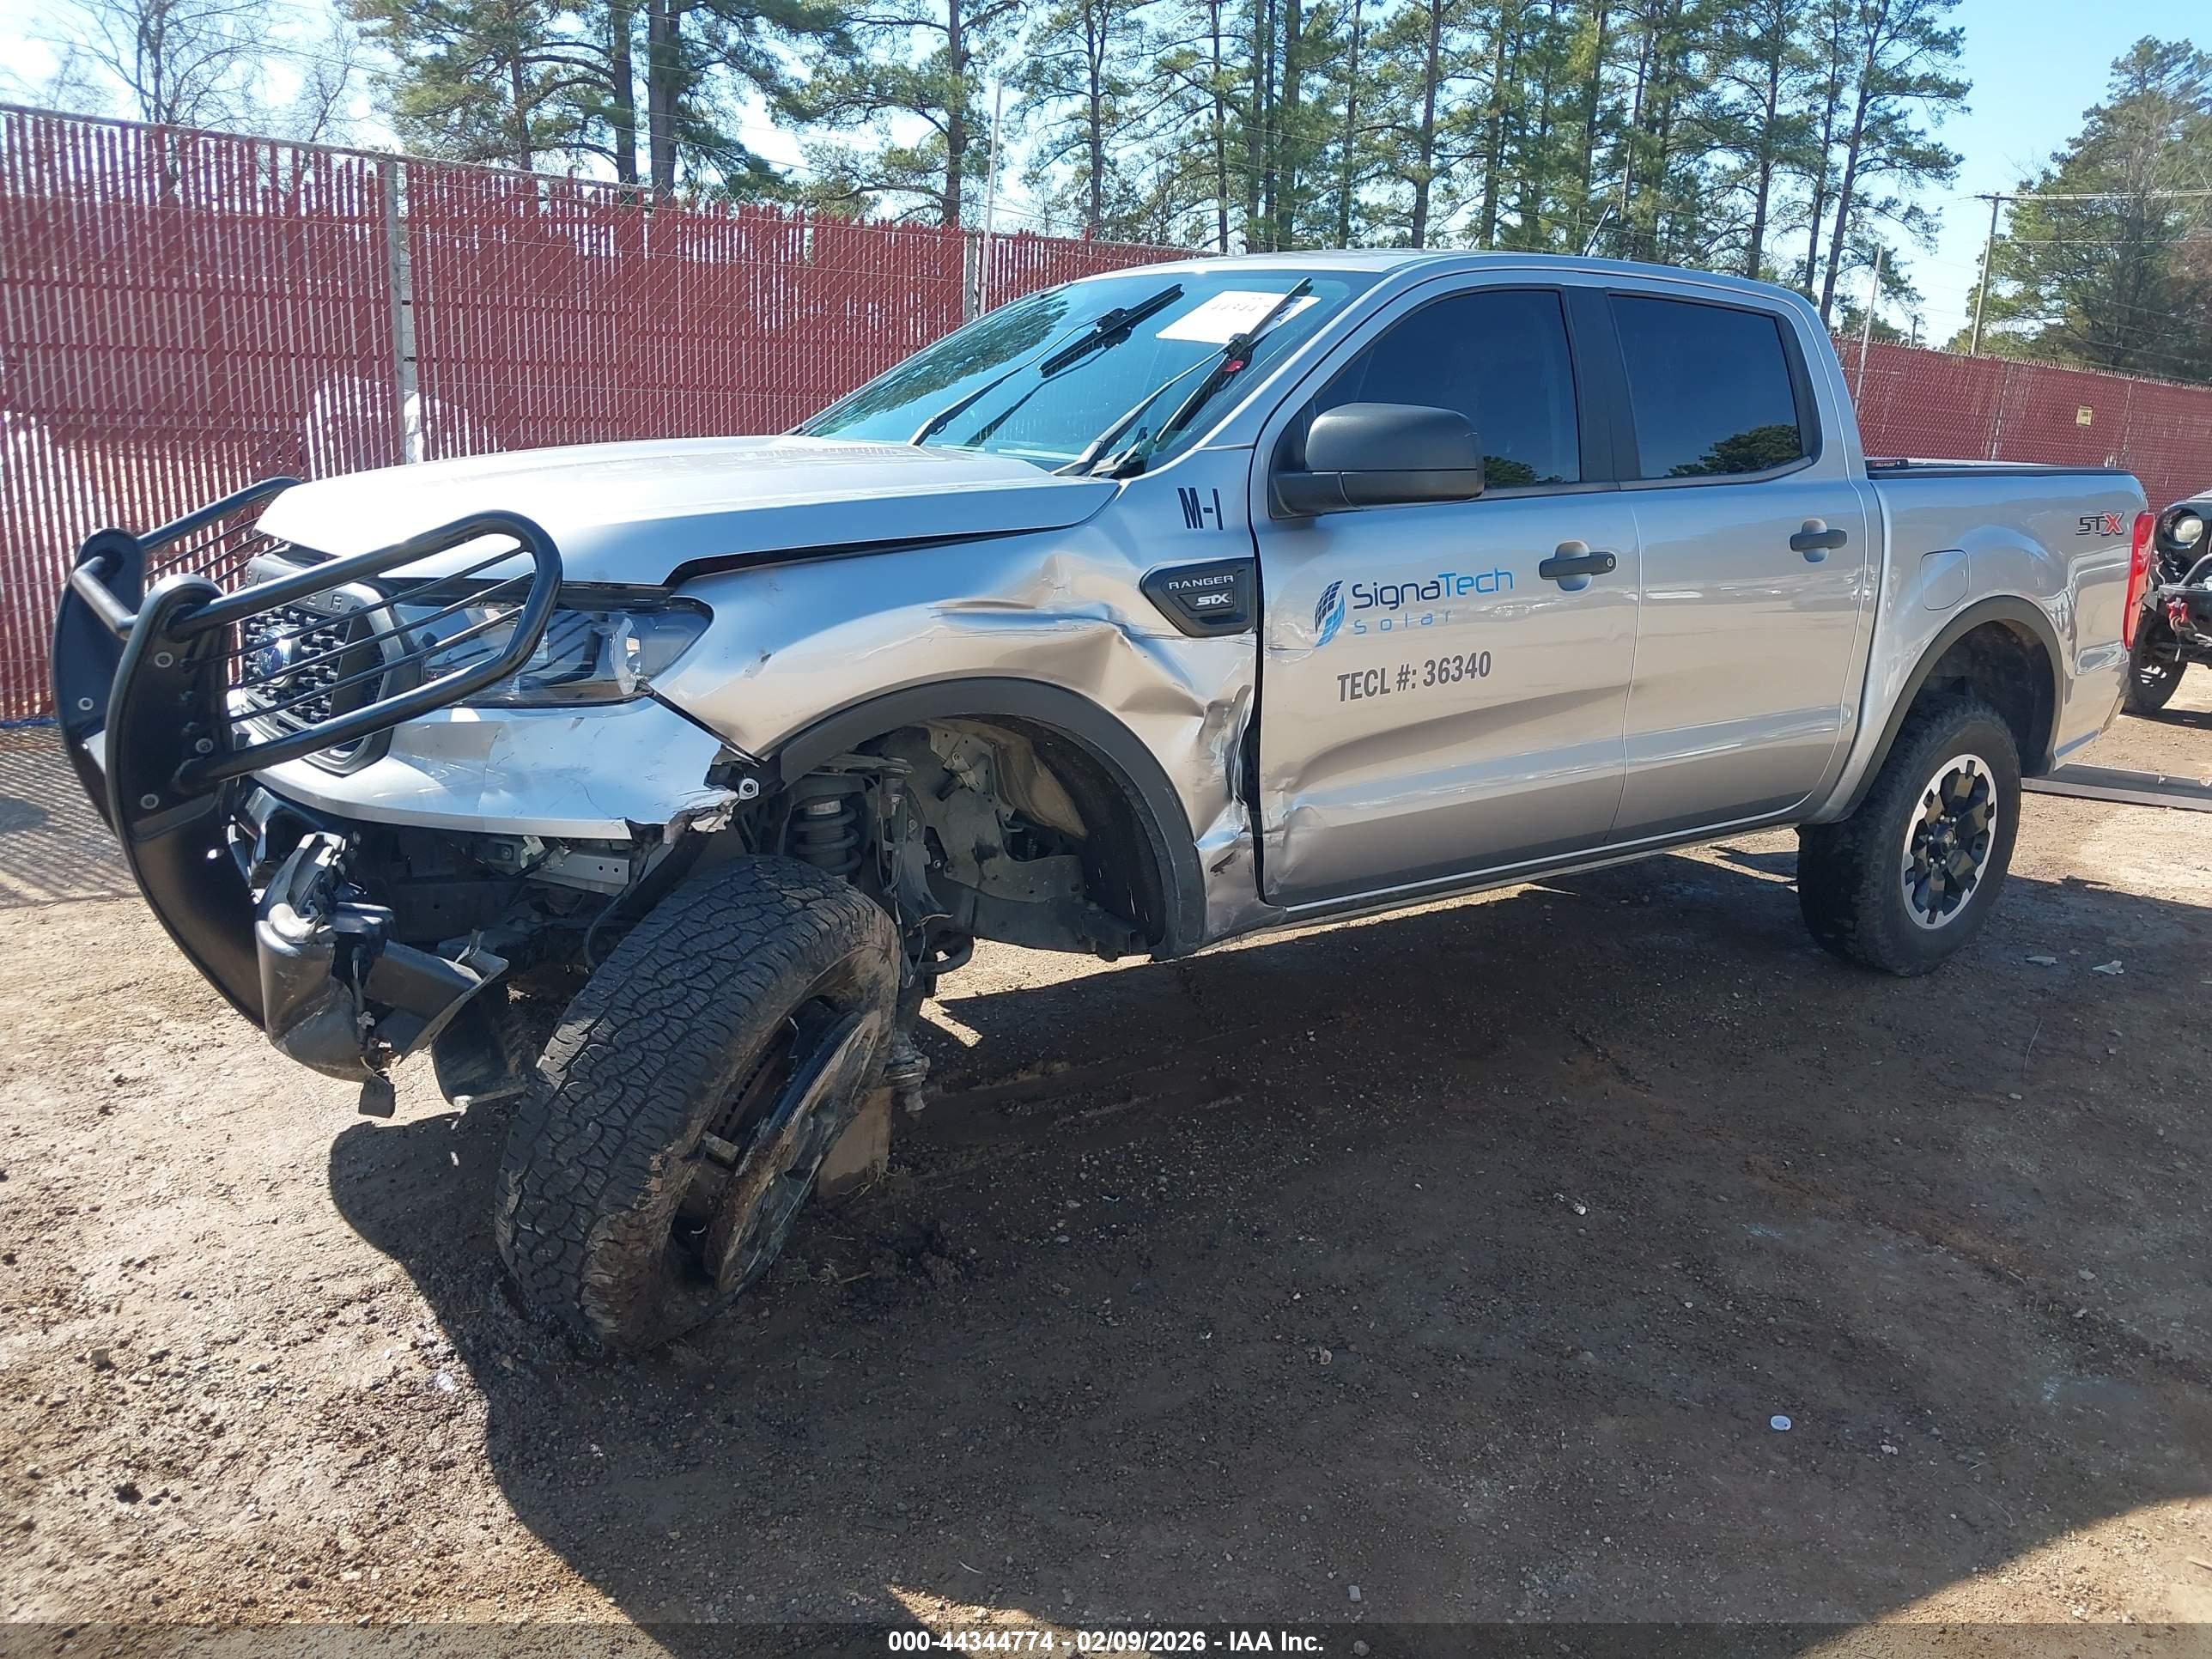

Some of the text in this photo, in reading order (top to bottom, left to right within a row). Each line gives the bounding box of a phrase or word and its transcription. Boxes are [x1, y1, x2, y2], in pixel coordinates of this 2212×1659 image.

[2076, 512, 2124, 536] STX
[1168, 574, 1235, 590] RANGER
[1352, 568, 1514, 611] SignaTech
[1195, 592, 1232, 607] STX
[1337, 650, 1492, 702] TECL #: 36340
